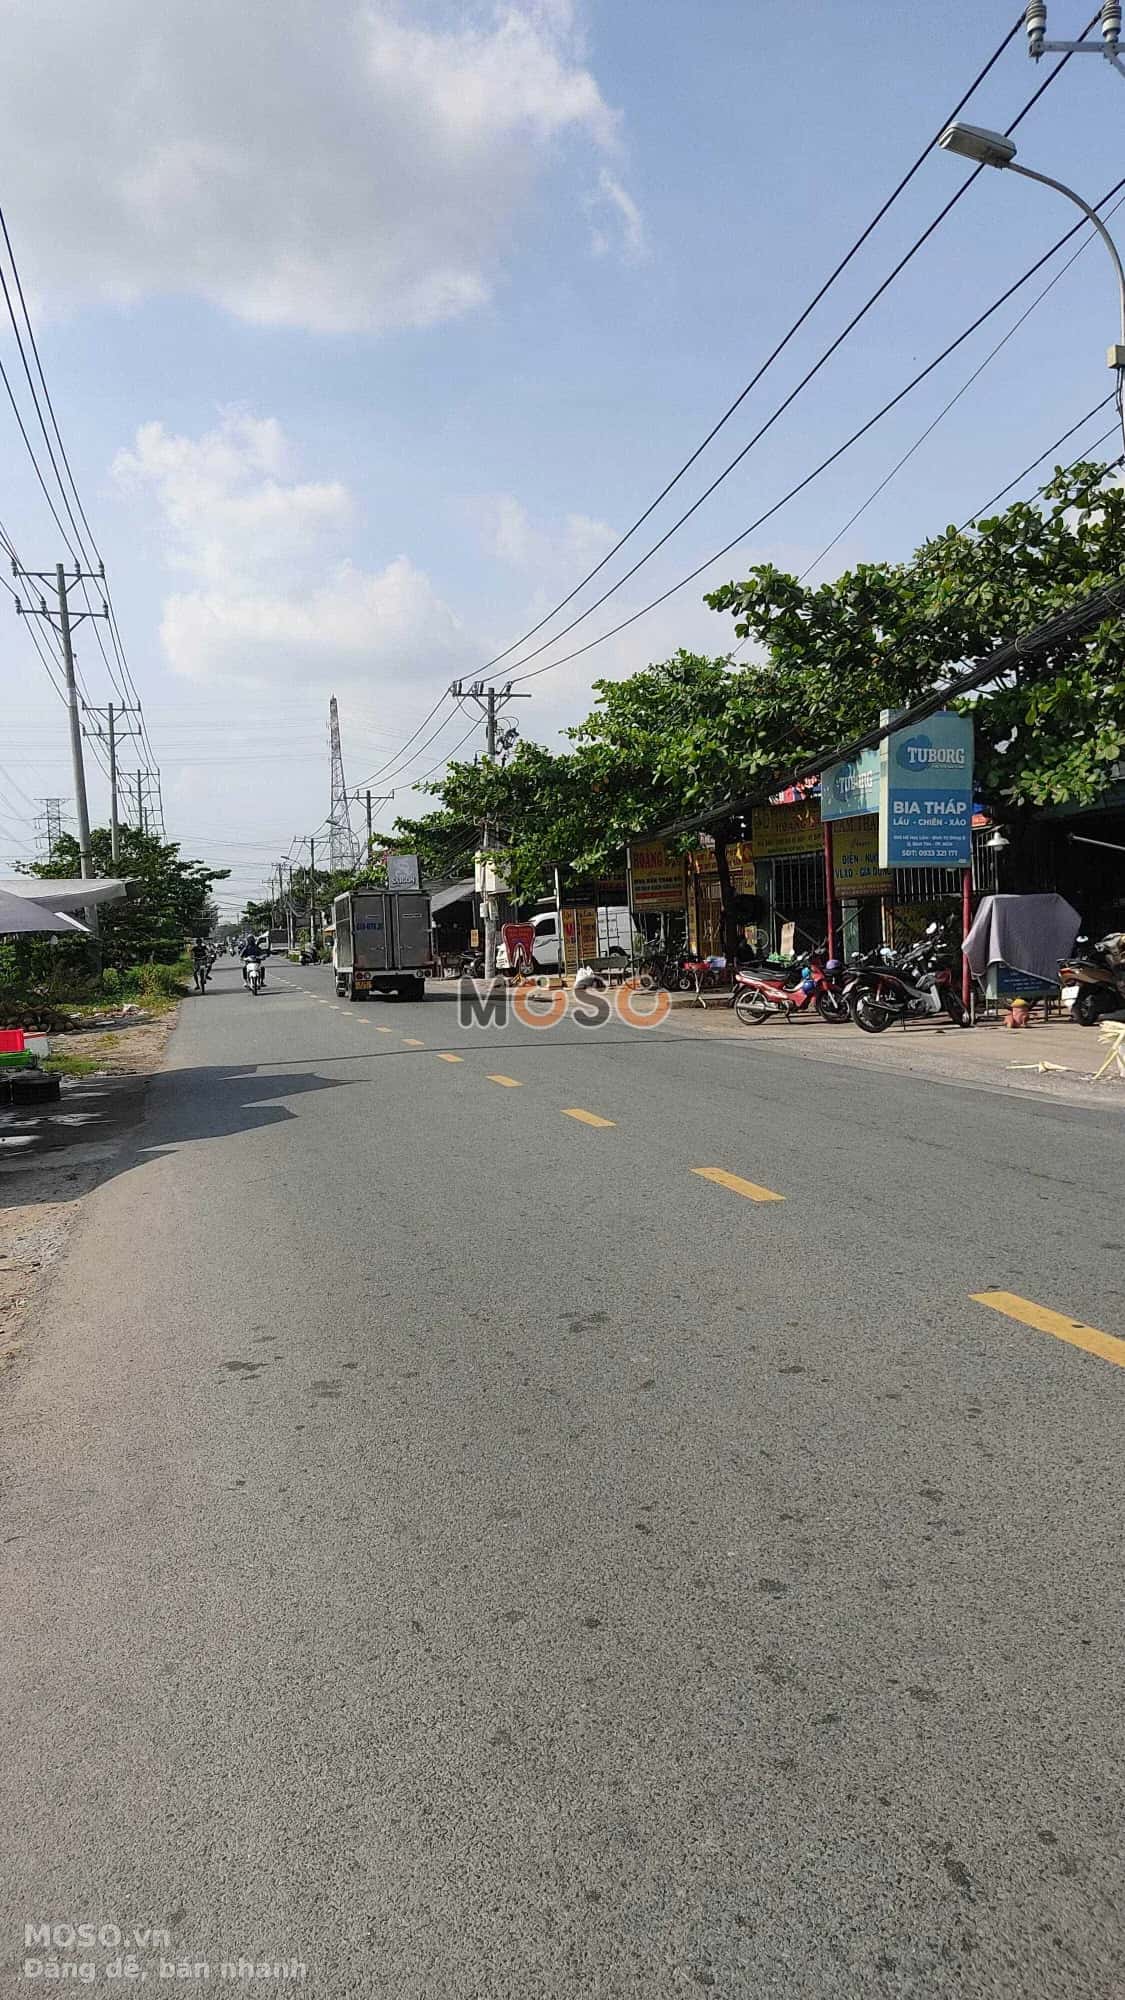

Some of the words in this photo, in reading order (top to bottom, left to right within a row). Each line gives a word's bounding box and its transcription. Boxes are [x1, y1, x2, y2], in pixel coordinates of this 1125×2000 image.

[907, 746, 965, 764] TUBORG
[893, 801, 920, 814] BIA
[924, 798, 967, 815] THÁP
